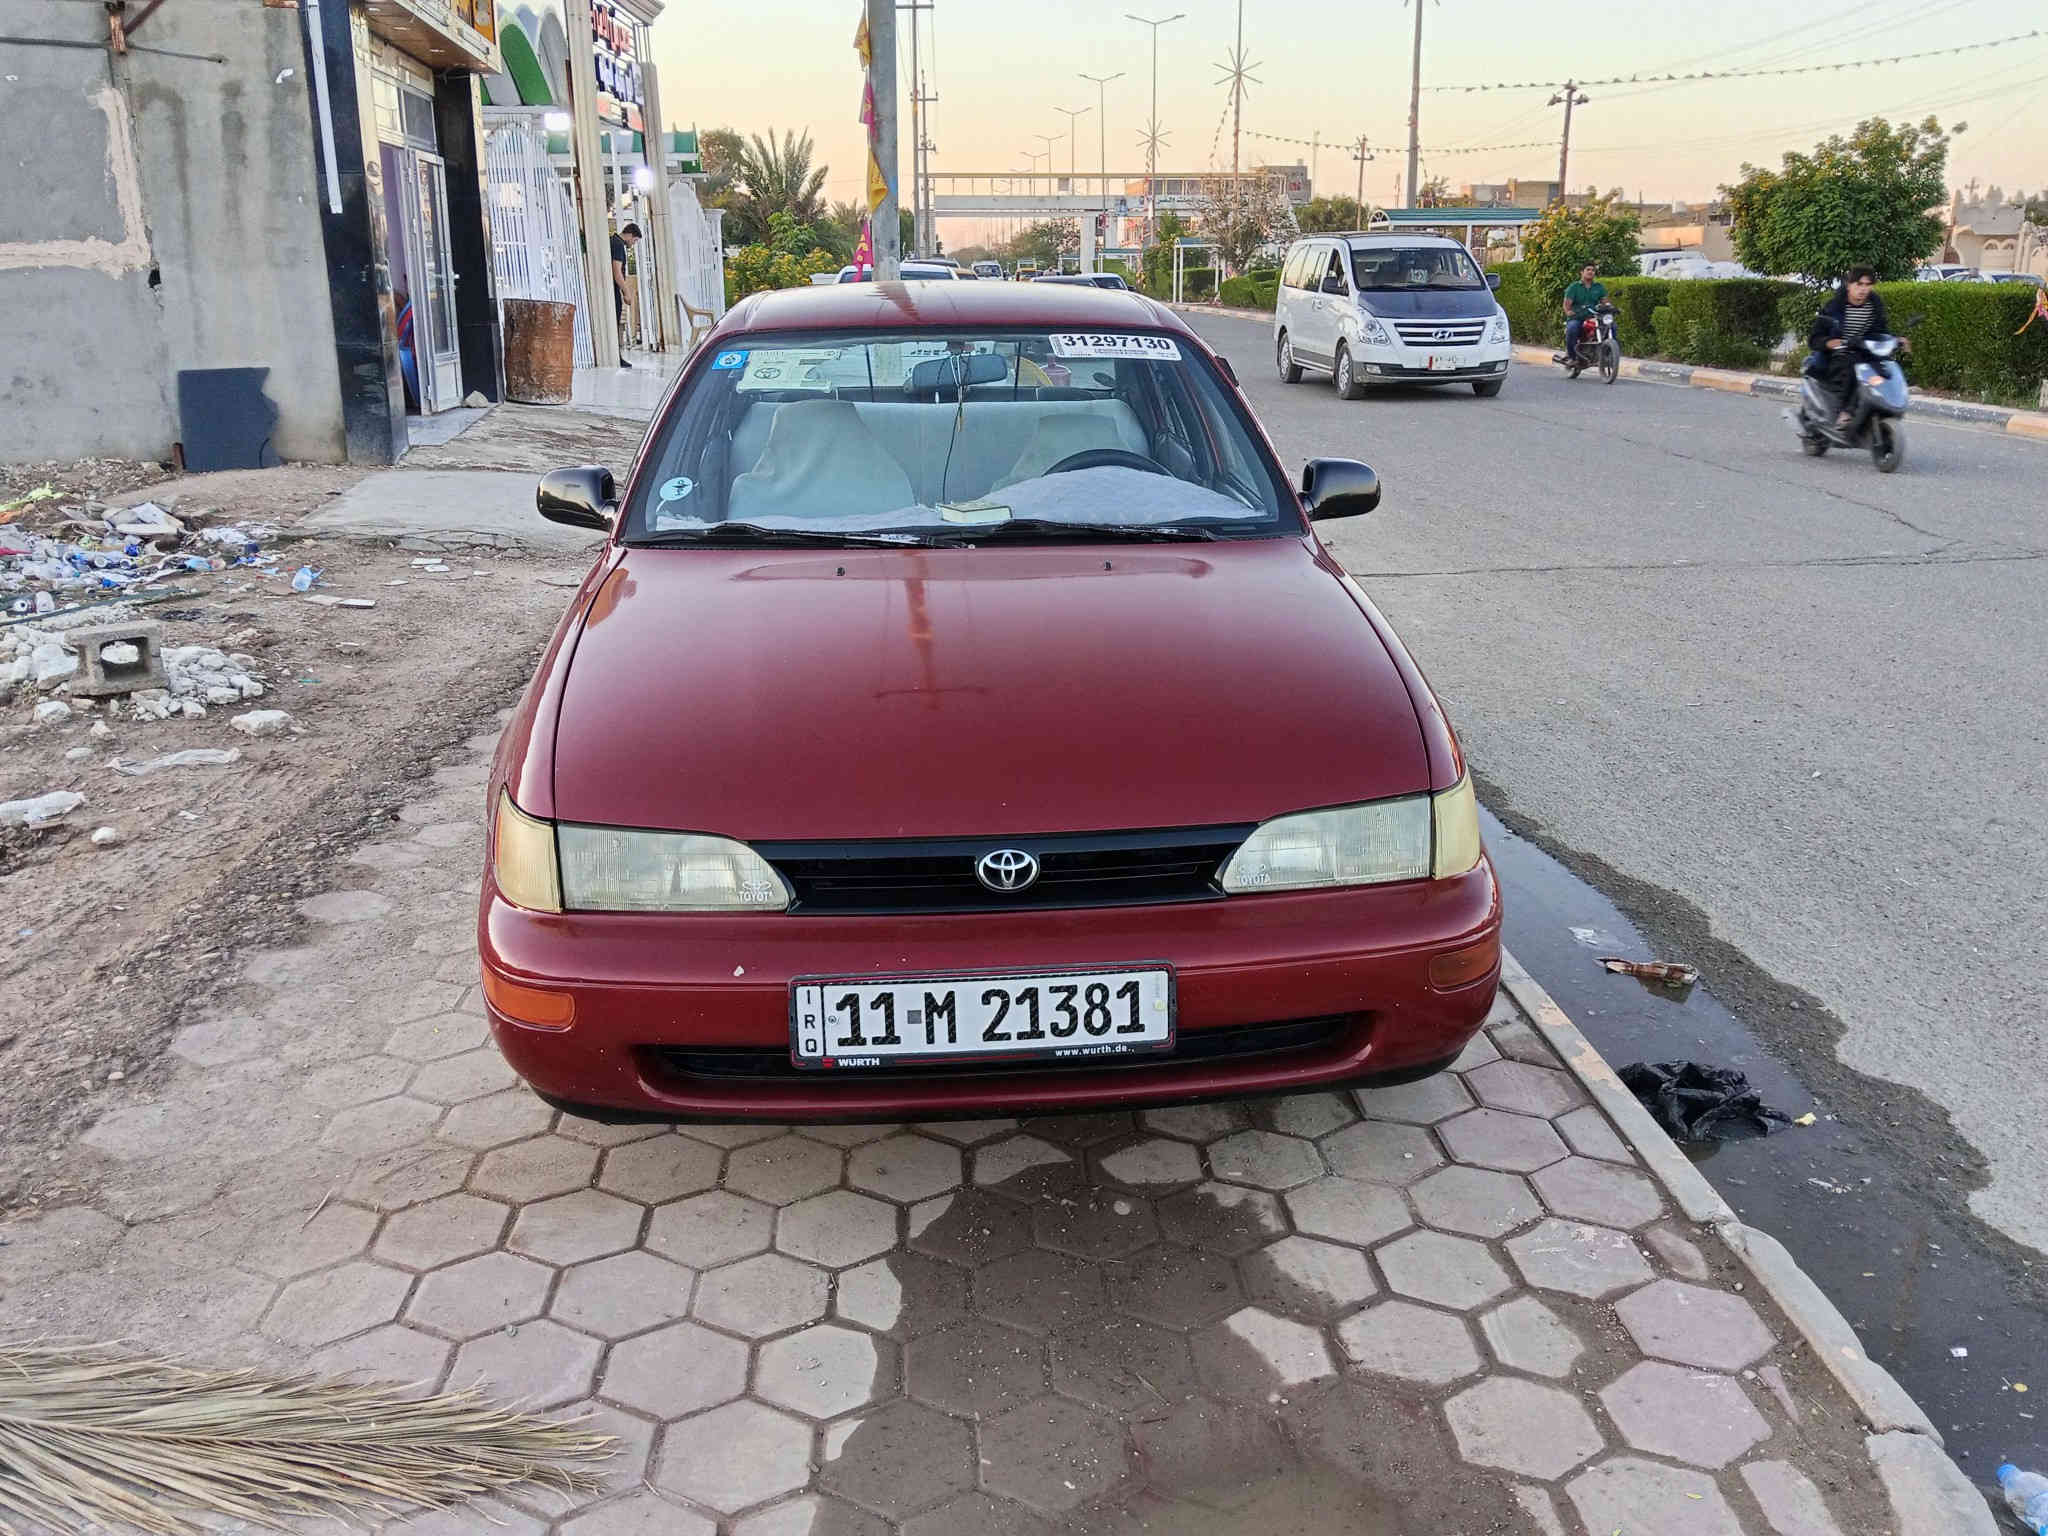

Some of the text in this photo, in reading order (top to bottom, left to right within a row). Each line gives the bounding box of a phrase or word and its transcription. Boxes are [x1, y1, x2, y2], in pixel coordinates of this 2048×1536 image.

[1062, 335, 1171, 350] 31297130
[981, 980, 1146, 1042] 21381
[837, 1057, 881, 1067] WURTH
